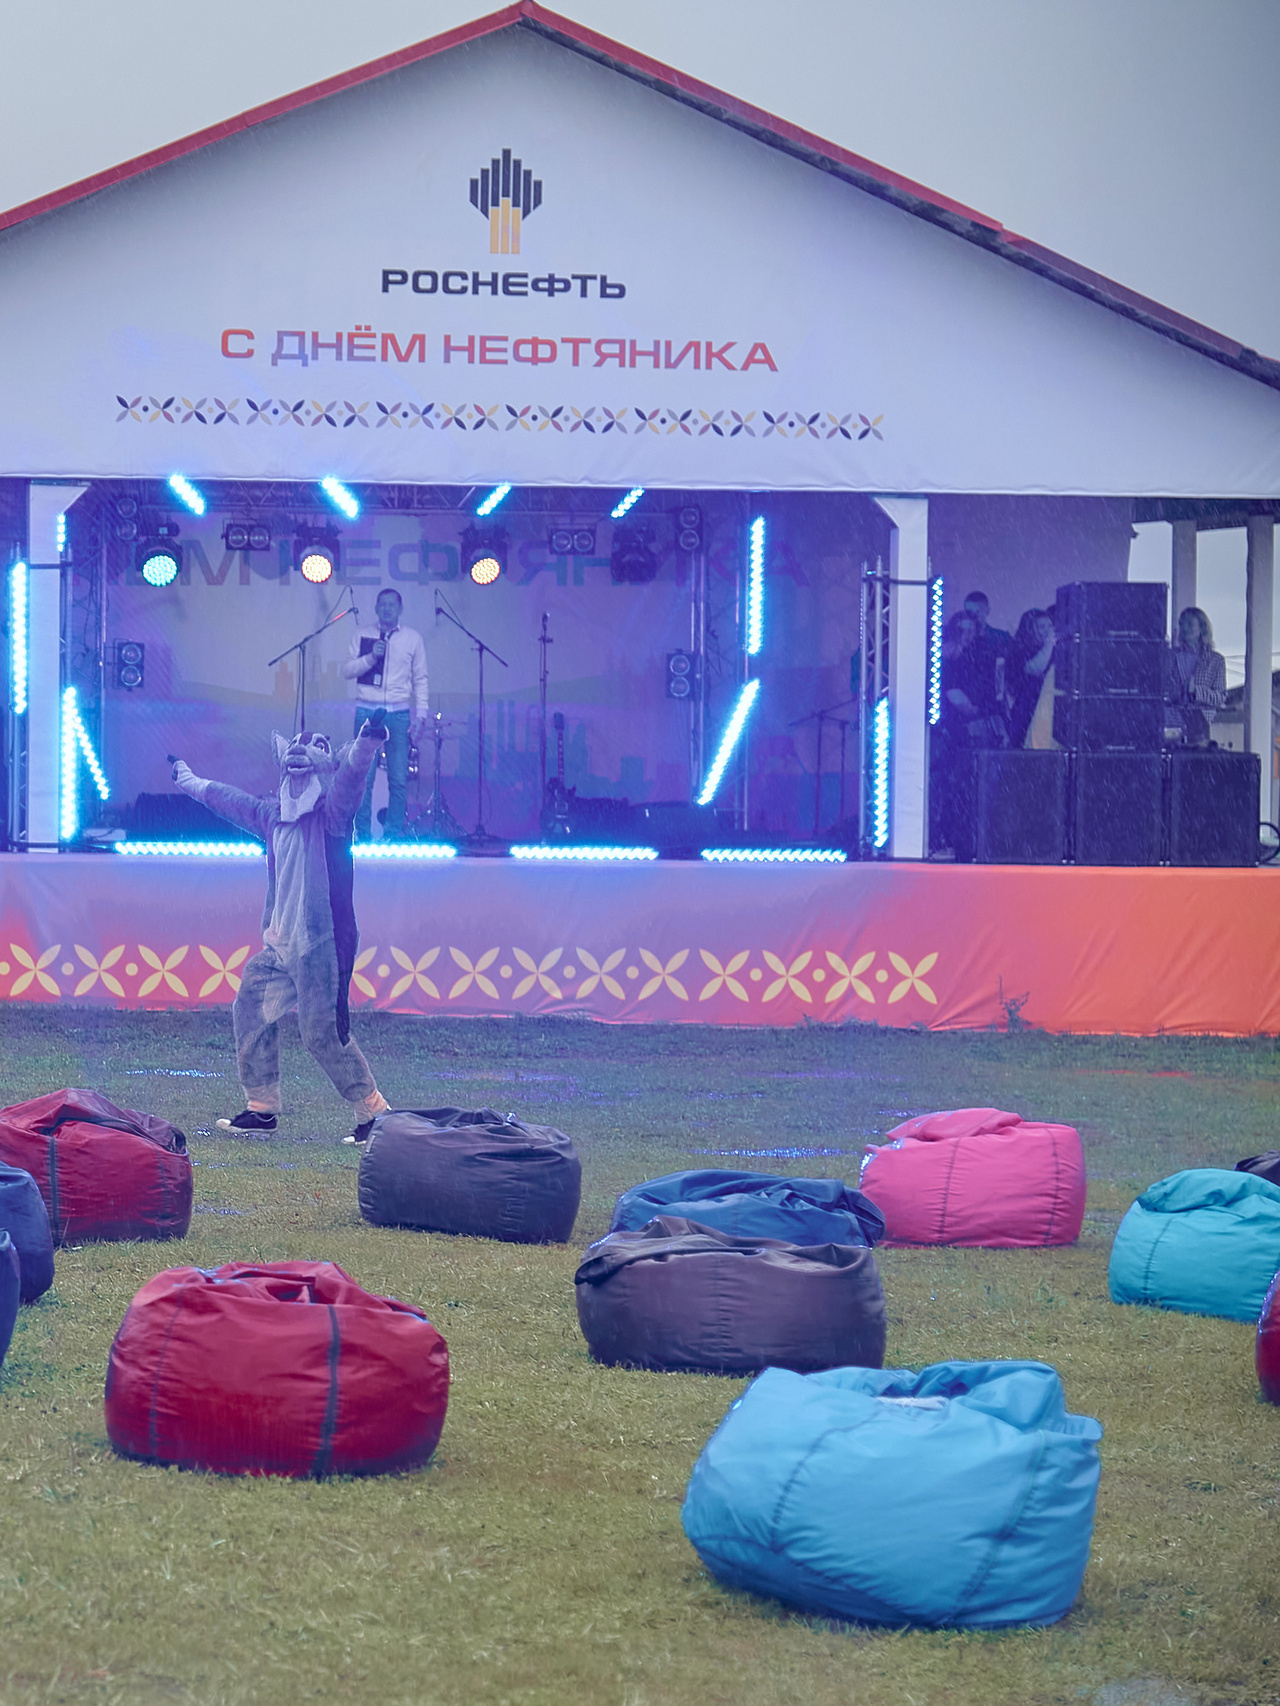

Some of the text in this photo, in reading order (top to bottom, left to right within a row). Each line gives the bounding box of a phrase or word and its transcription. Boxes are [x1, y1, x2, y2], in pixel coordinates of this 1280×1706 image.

[381, 268, 626, 299] РОСНЕФТЬ
[221, 324, 779, 372] С ДНЁМ НЕФТЯНИКА
